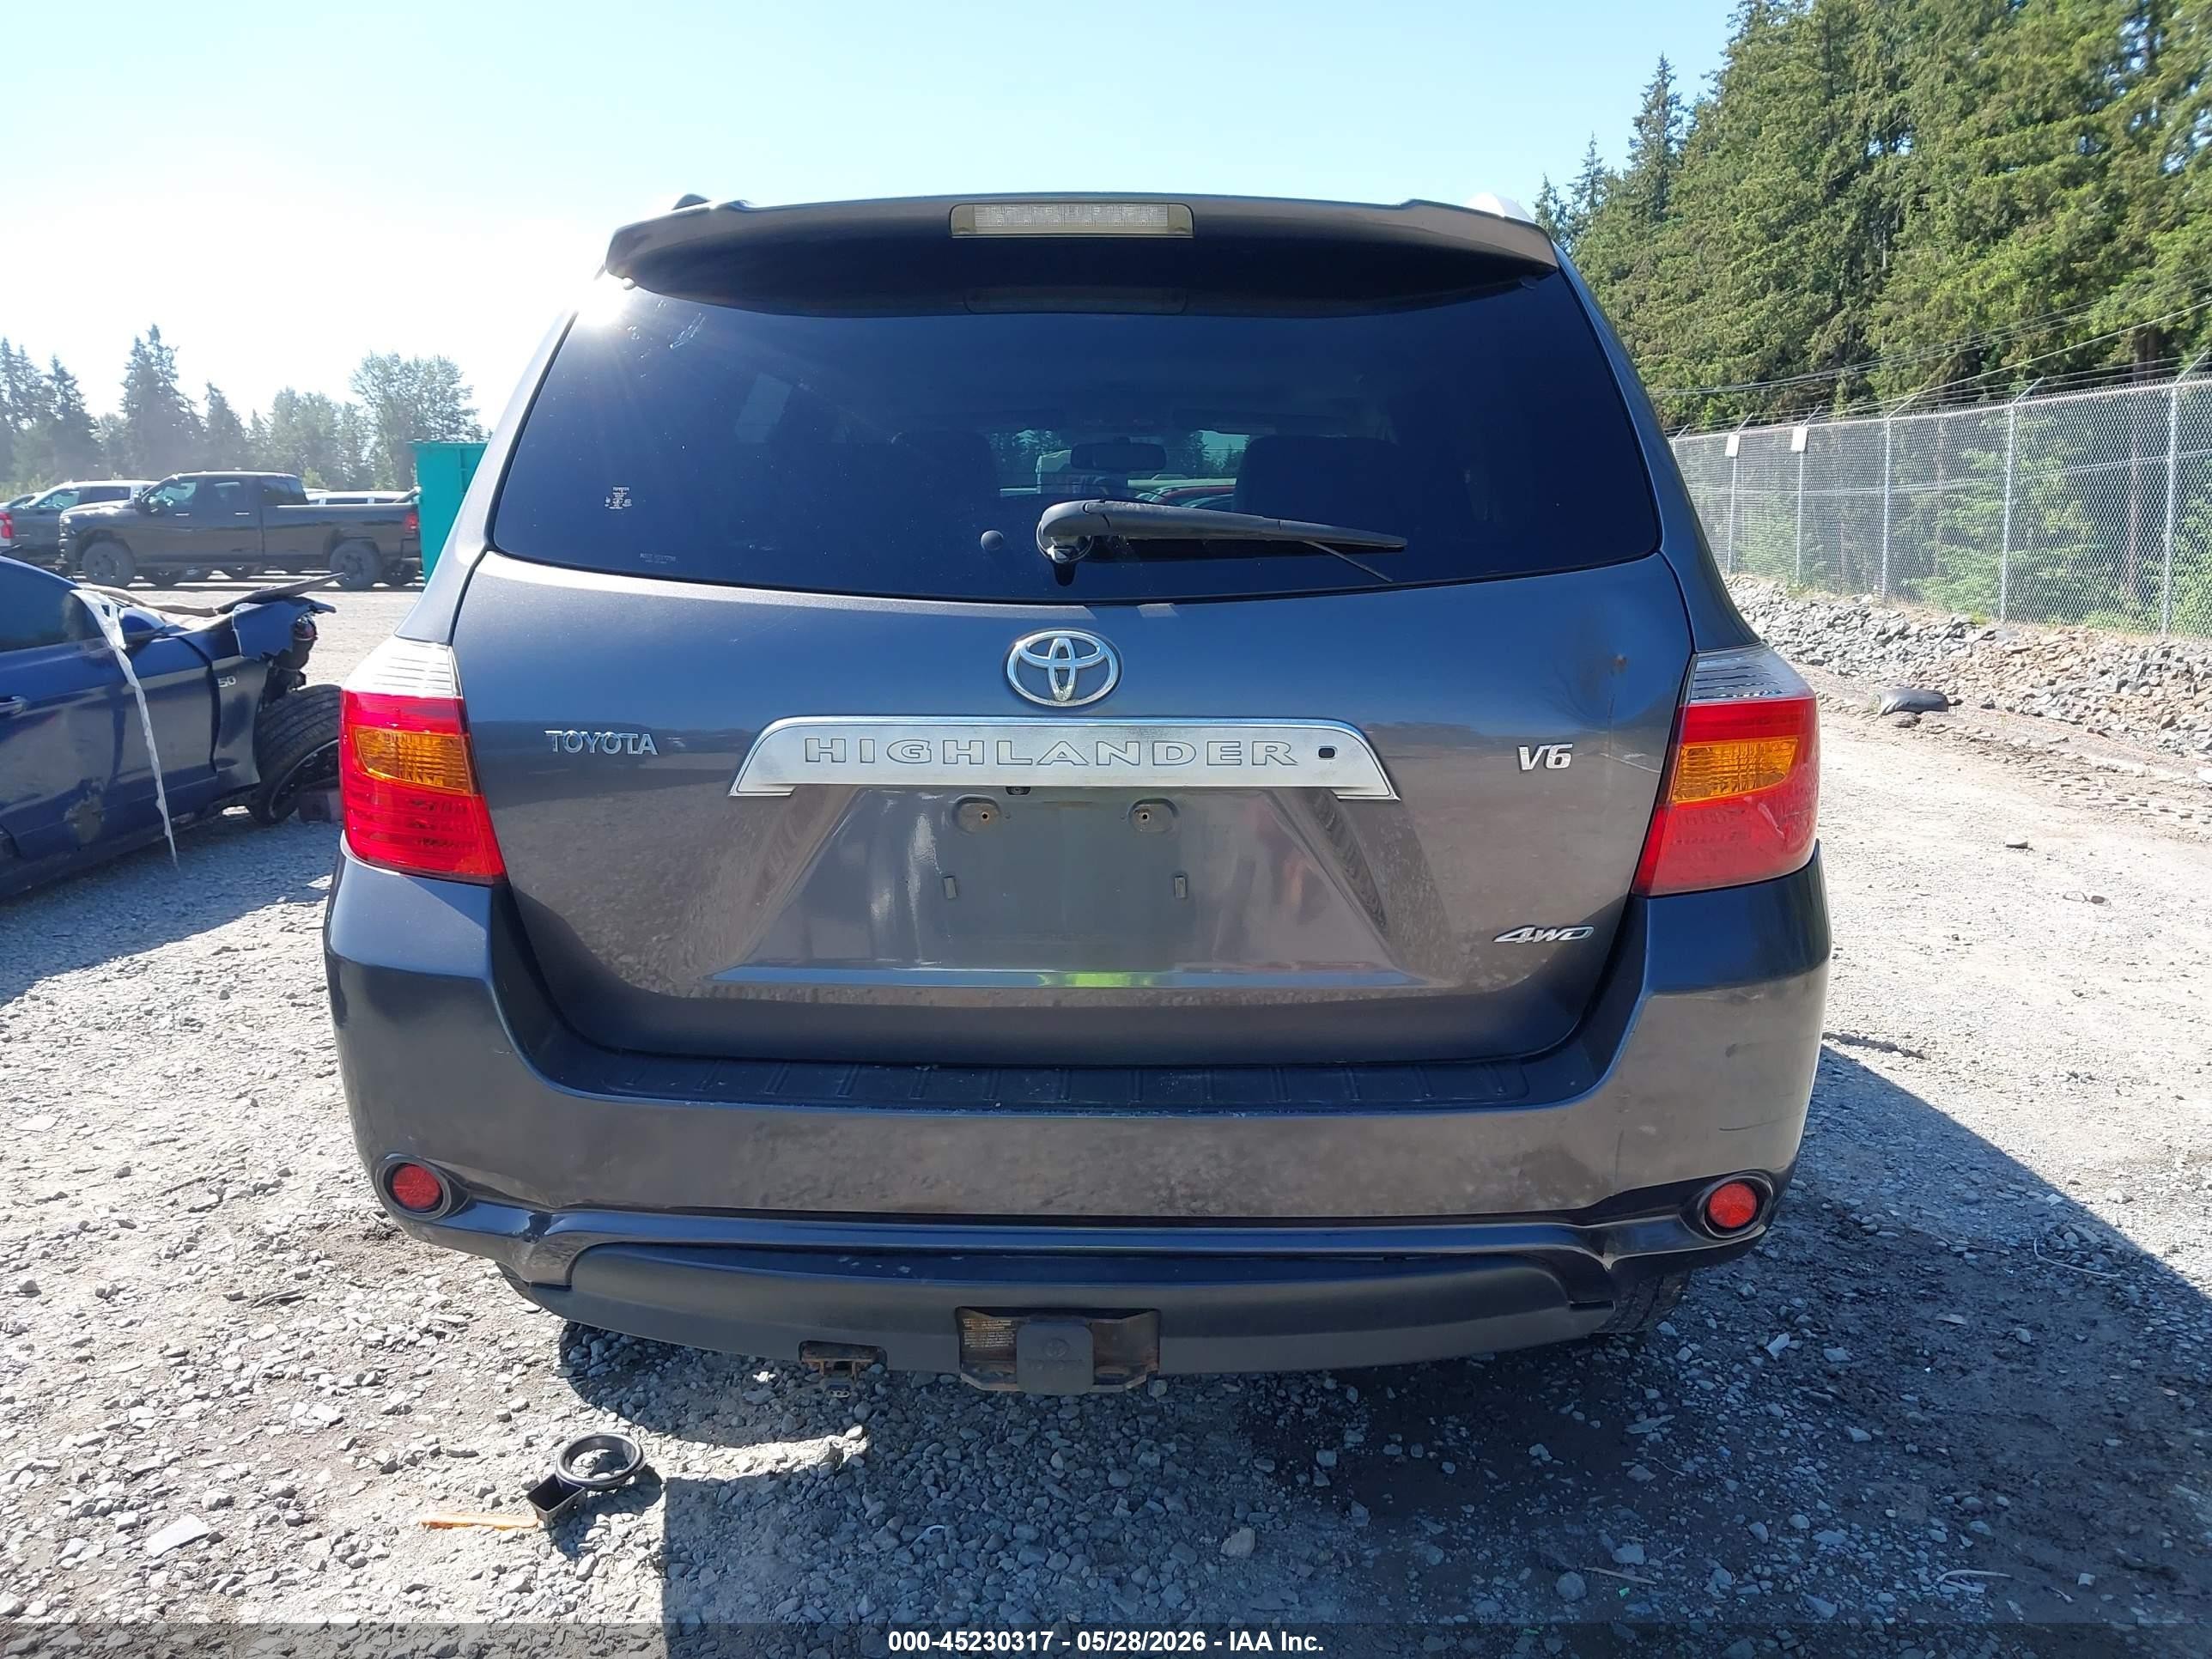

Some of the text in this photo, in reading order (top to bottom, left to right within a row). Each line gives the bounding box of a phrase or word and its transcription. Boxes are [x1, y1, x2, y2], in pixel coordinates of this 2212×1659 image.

[544, 729, 659, 757] TOYOTA
[804, 737, 1298, 767] HIGHLANDER
[1517, 743, 1573, 771] V6
[1492, 925, 1595, 944] 4WD
